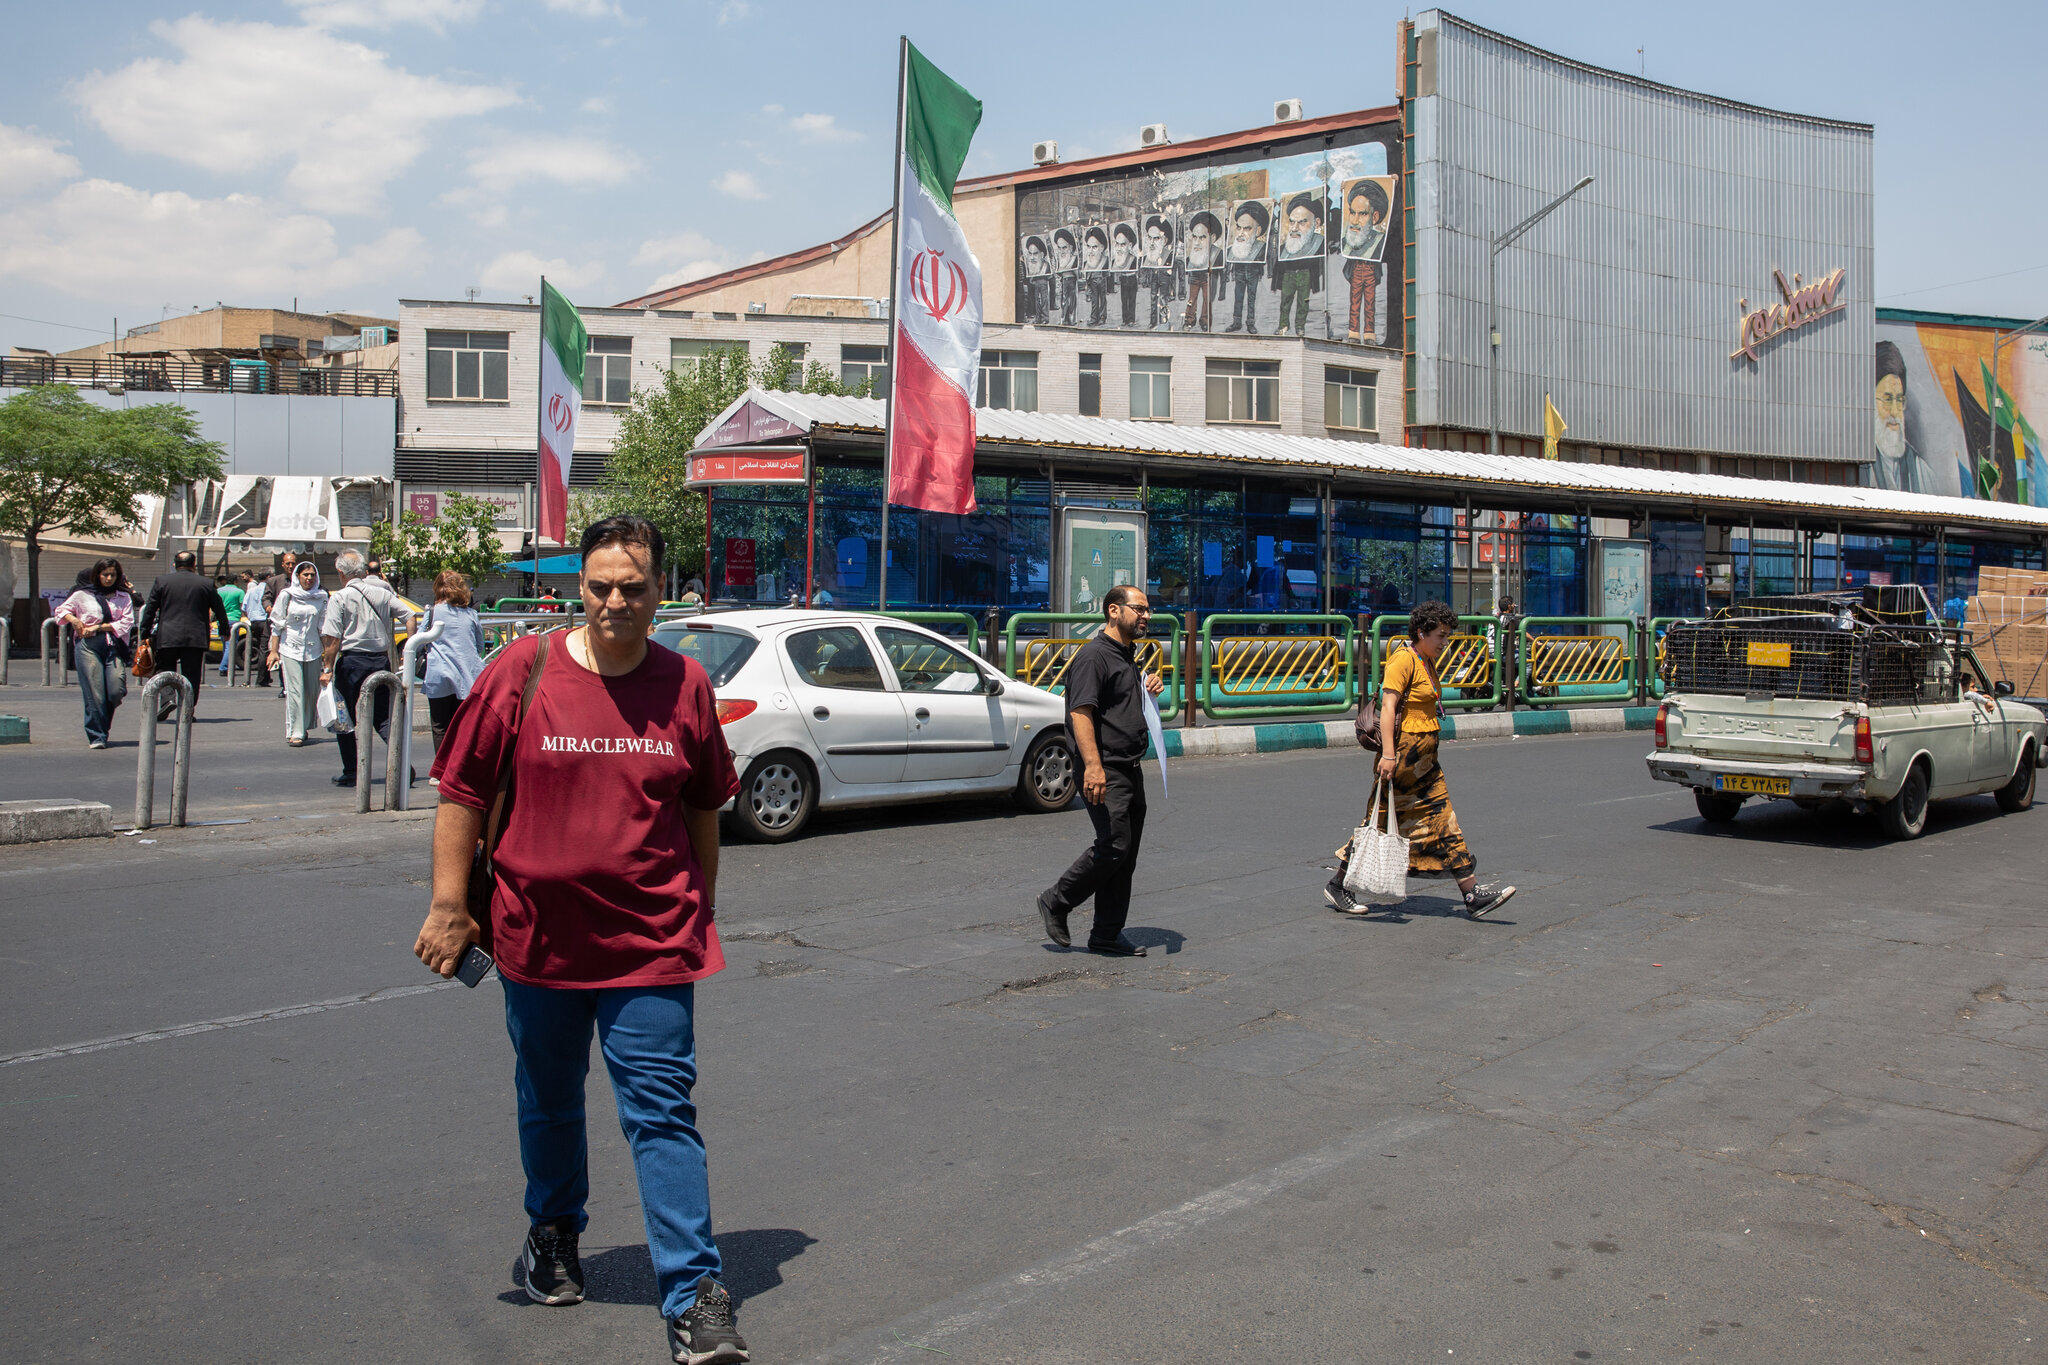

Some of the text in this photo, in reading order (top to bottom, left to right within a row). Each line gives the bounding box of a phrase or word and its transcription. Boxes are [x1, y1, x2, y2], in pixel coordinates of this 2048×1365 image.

[739, 461, 799, 471] میدان انقلاب اسلامی
[541, 735, 675, 757] MIRACLEWEAR
